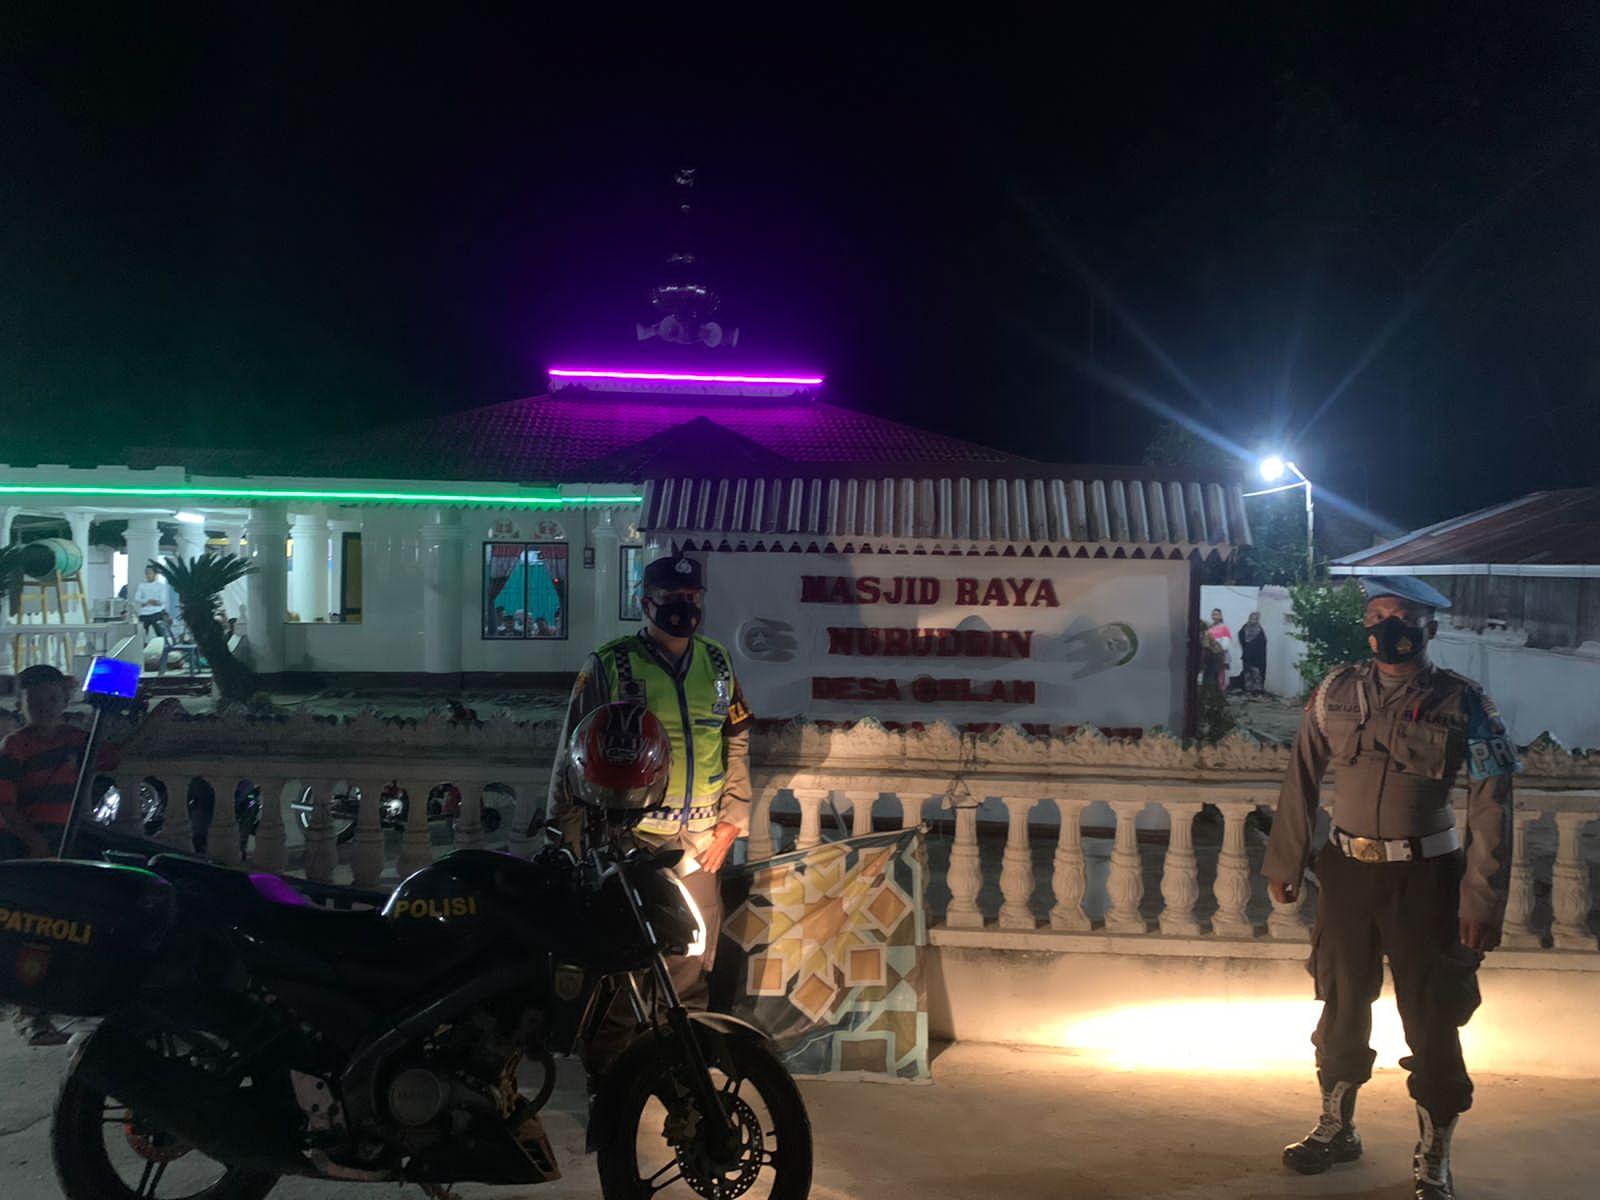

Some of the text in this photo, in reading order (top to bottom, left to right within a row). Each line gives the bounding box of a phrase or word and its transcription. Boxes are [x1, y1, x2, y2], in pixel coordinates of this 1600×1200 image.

[801, 575, 1060, 608] MASJID RAYA
[393, 896, 480, 920] POLISI
[0, 906, 94, 945] PATROLI
